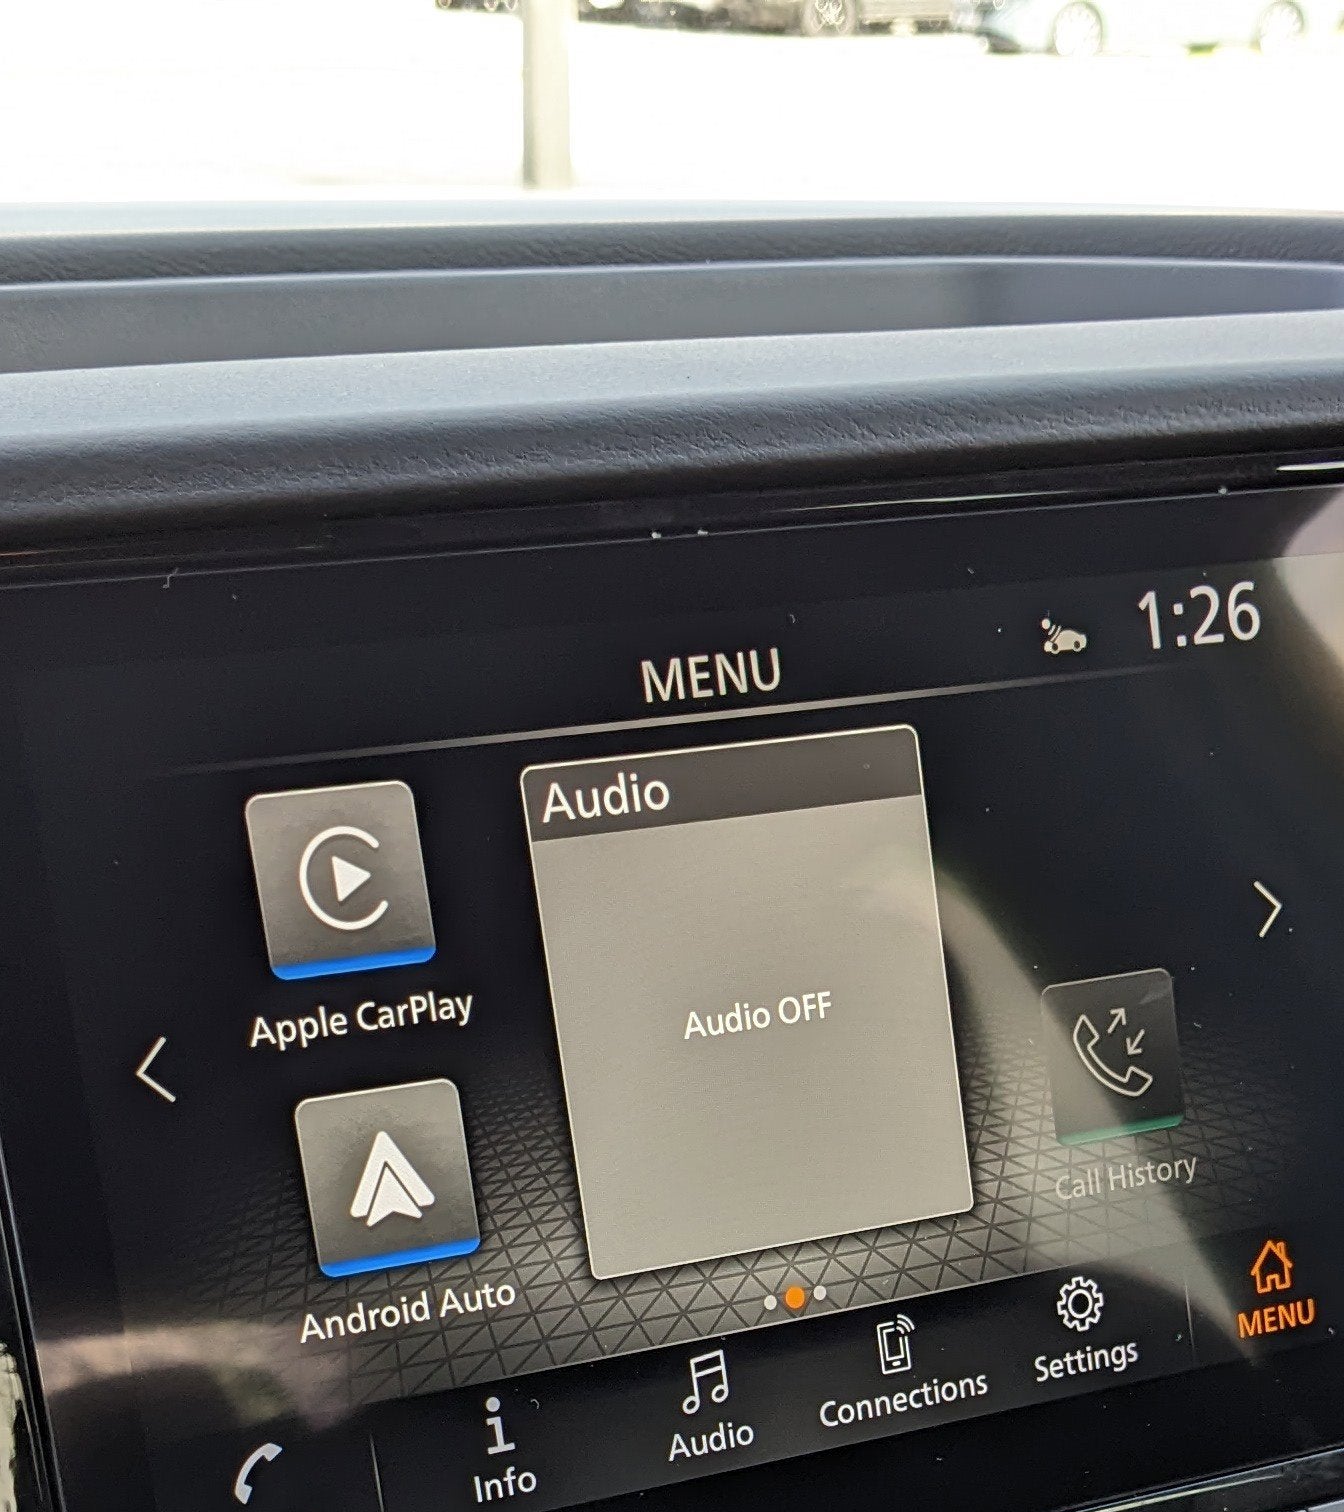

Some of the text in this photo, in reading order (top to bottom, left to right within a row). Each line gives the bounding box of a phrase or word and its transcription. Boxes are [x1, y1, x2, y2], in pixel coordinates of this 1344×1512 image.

[1138, 581, 1262, 651] 1:26
[641, 648, 783, 704] MENU
[541, 773, 671, 824] Audio
[249, 991, 475, 1052] Apple CarPlay
[683, 991, 833, 1041] Audio OFF
[1055, 1155, 1199, 1200] Call History
[298, 1280, 517, 1345] Android Auto
[1236, 1297, 1317, 1339] MENU
[1033, 1340, 1139, 1383] Settings
[818, 1369, 989, 1428] Connections
[667, 1419, 754, 1462] Audio
[472, 1467, 537, 1503] Info
